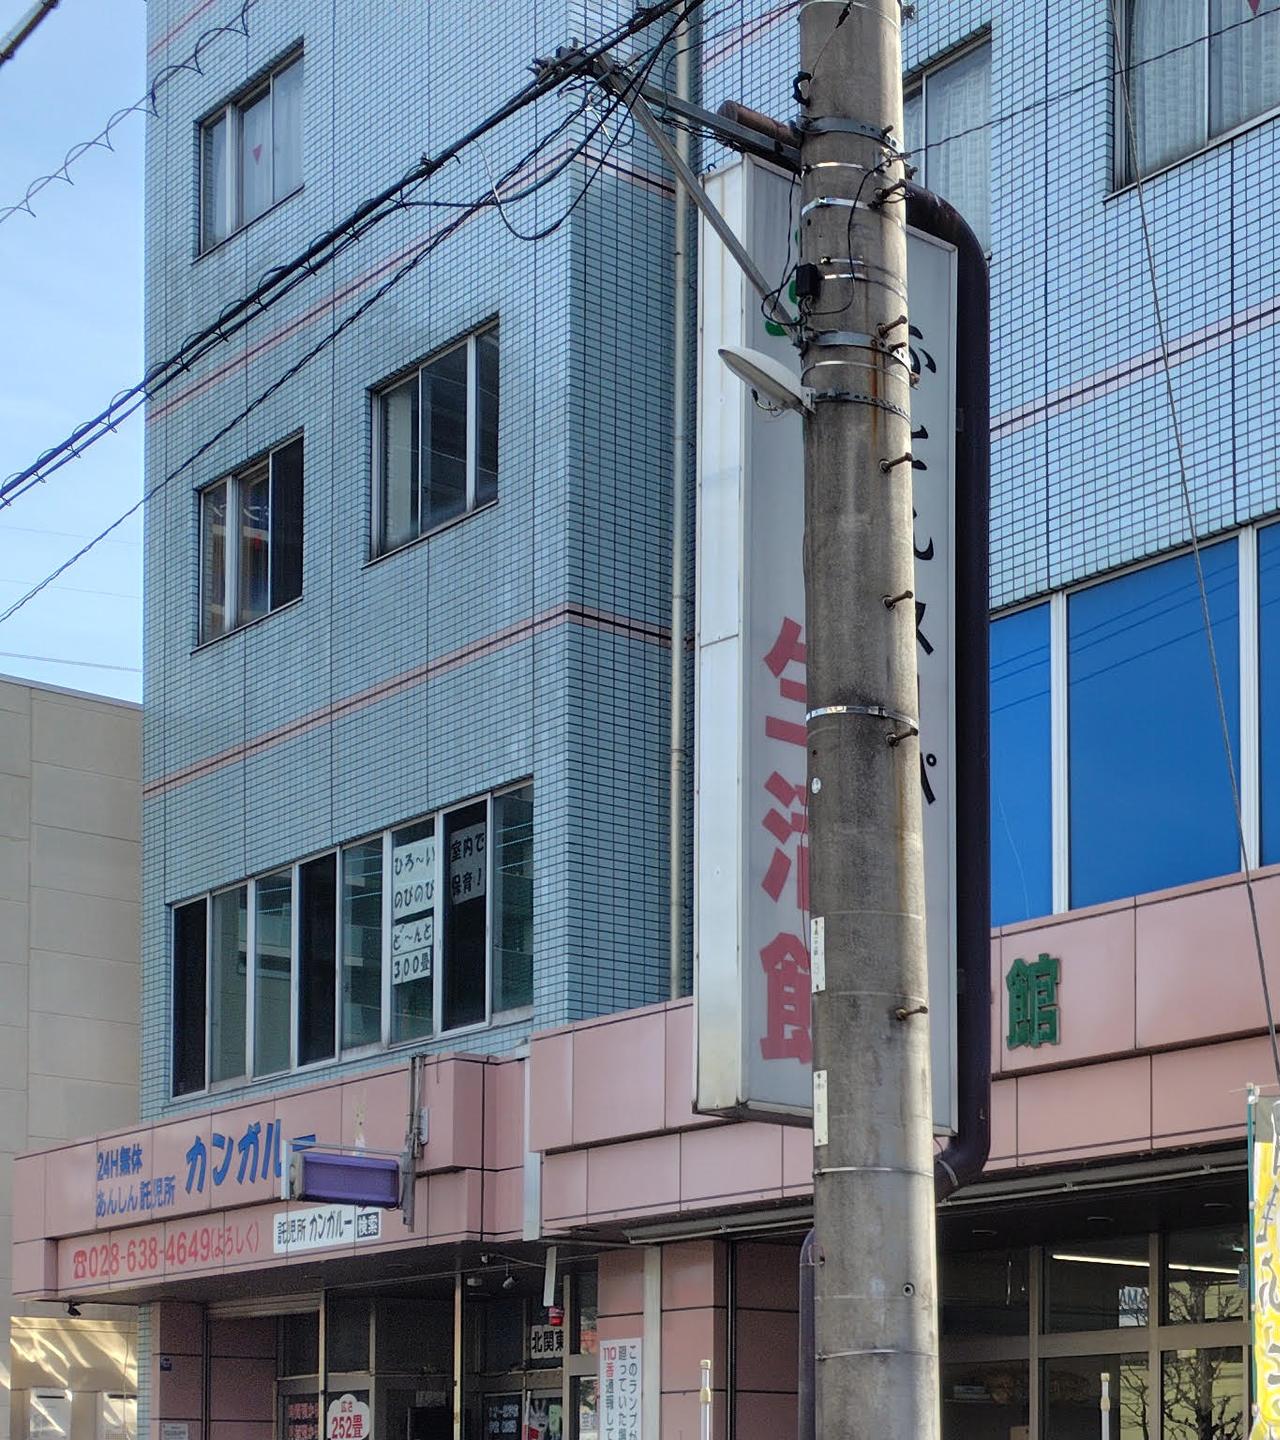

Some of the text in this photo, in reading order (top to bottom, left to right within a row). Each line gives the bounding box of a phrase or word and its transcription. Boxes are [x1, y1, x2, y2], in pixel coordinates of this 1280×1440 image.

[451, 832, 485, 863] 室内で
[394, 952, 430, 979] 300畳
[1006, 953, 1059, 1051] 館
[96, 1143, 143, 1181] 24H無休
[185, 1119, 316, 1194] カンガルー
[309, 1210, 353, 1242] カンガルー
[331, 1414, 363, 1440] 252畳
